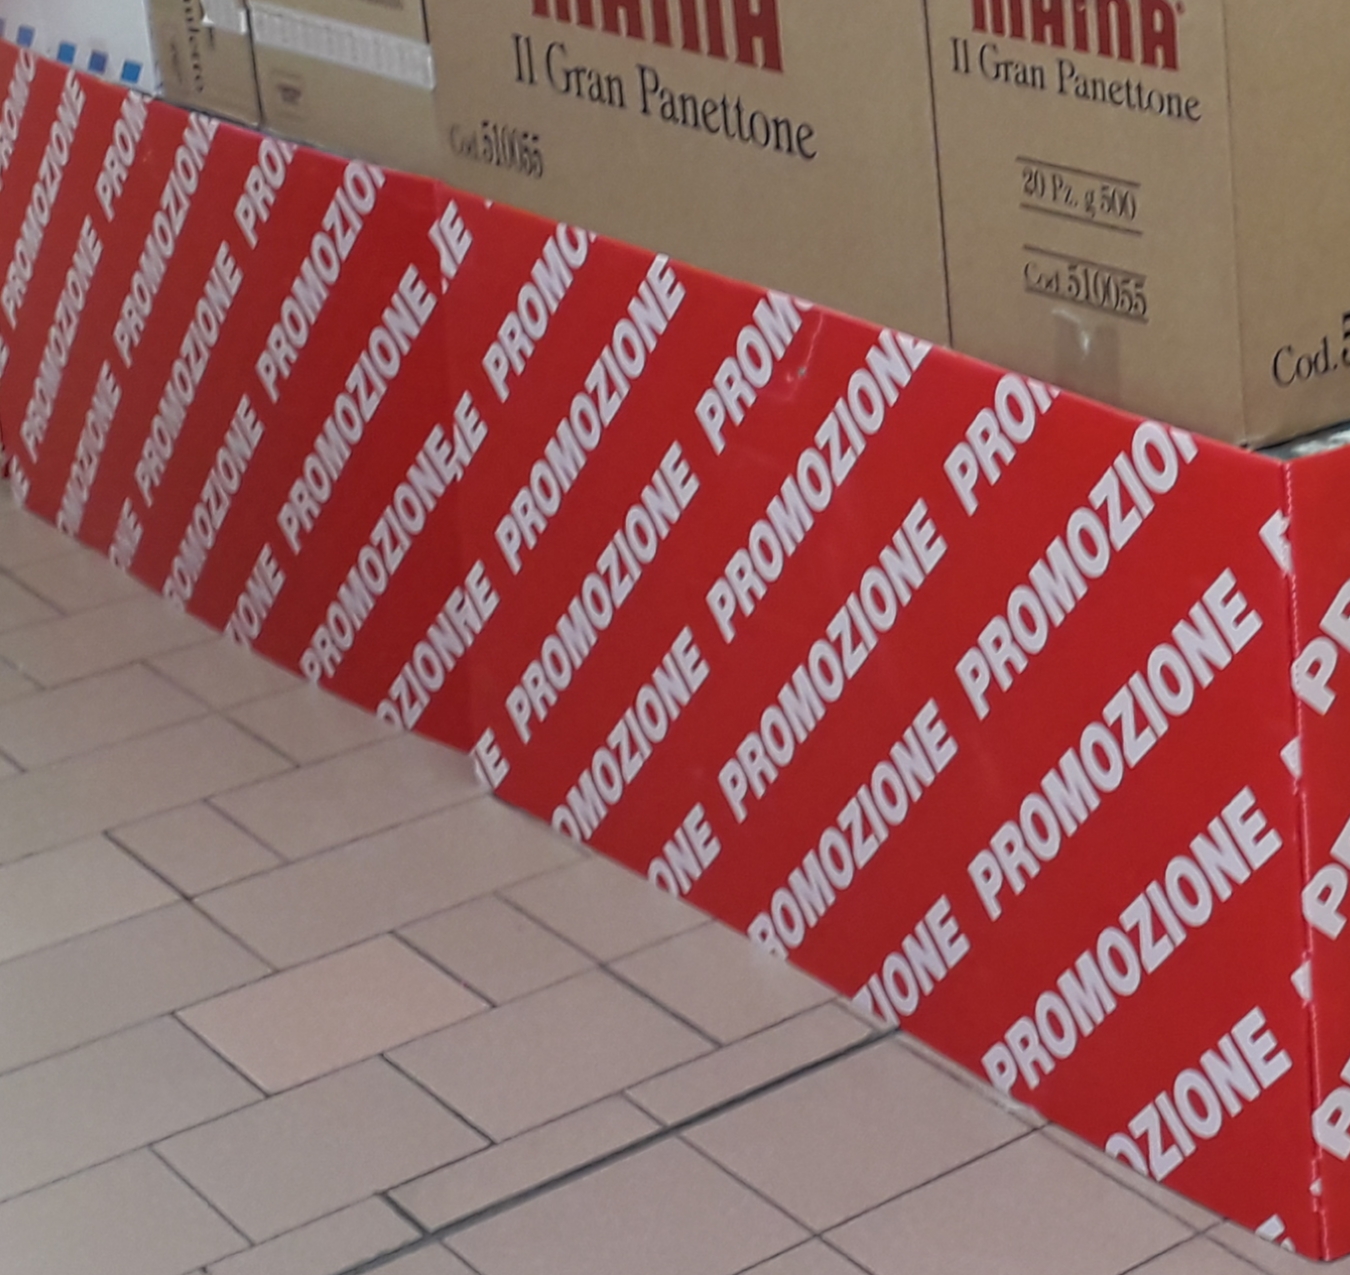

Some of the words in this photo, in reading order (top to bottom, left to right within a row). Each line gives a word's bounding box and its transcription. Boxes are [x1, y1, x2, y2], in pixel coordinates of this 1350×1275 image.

[2, 68, 86, 330] PROMOZIONE
[512, 33, 538, 85] Il
[545, 42, 628, 110] Gran
[637, 63, 818, 160] Panettone
[951, 37, 970, 74] Il
[979, 43, 1046, 91] Gran
[1056, 58, 1202, 122] Panettone
[1022, 166, 1046, 198] 20
[1084, 189, 1096, 218] g
[1100, 185, 1137, 221] 500
[20, 214, 103, 464] PROMOZIONE
[134, 240, 244, 508] PROMOZIONE
[277, 262, 437, 555] PROMOZIONE
[494, 253, 686, 576] PROMOZIONE
[505, 440, 700, 744] PROMOZIONE
[718, 498, 948, 823] PROMOZIONE
[967, 567, 1263, 923] PROMOZIONE
[981, 784, 1283, 1094] PROMOZIONE
